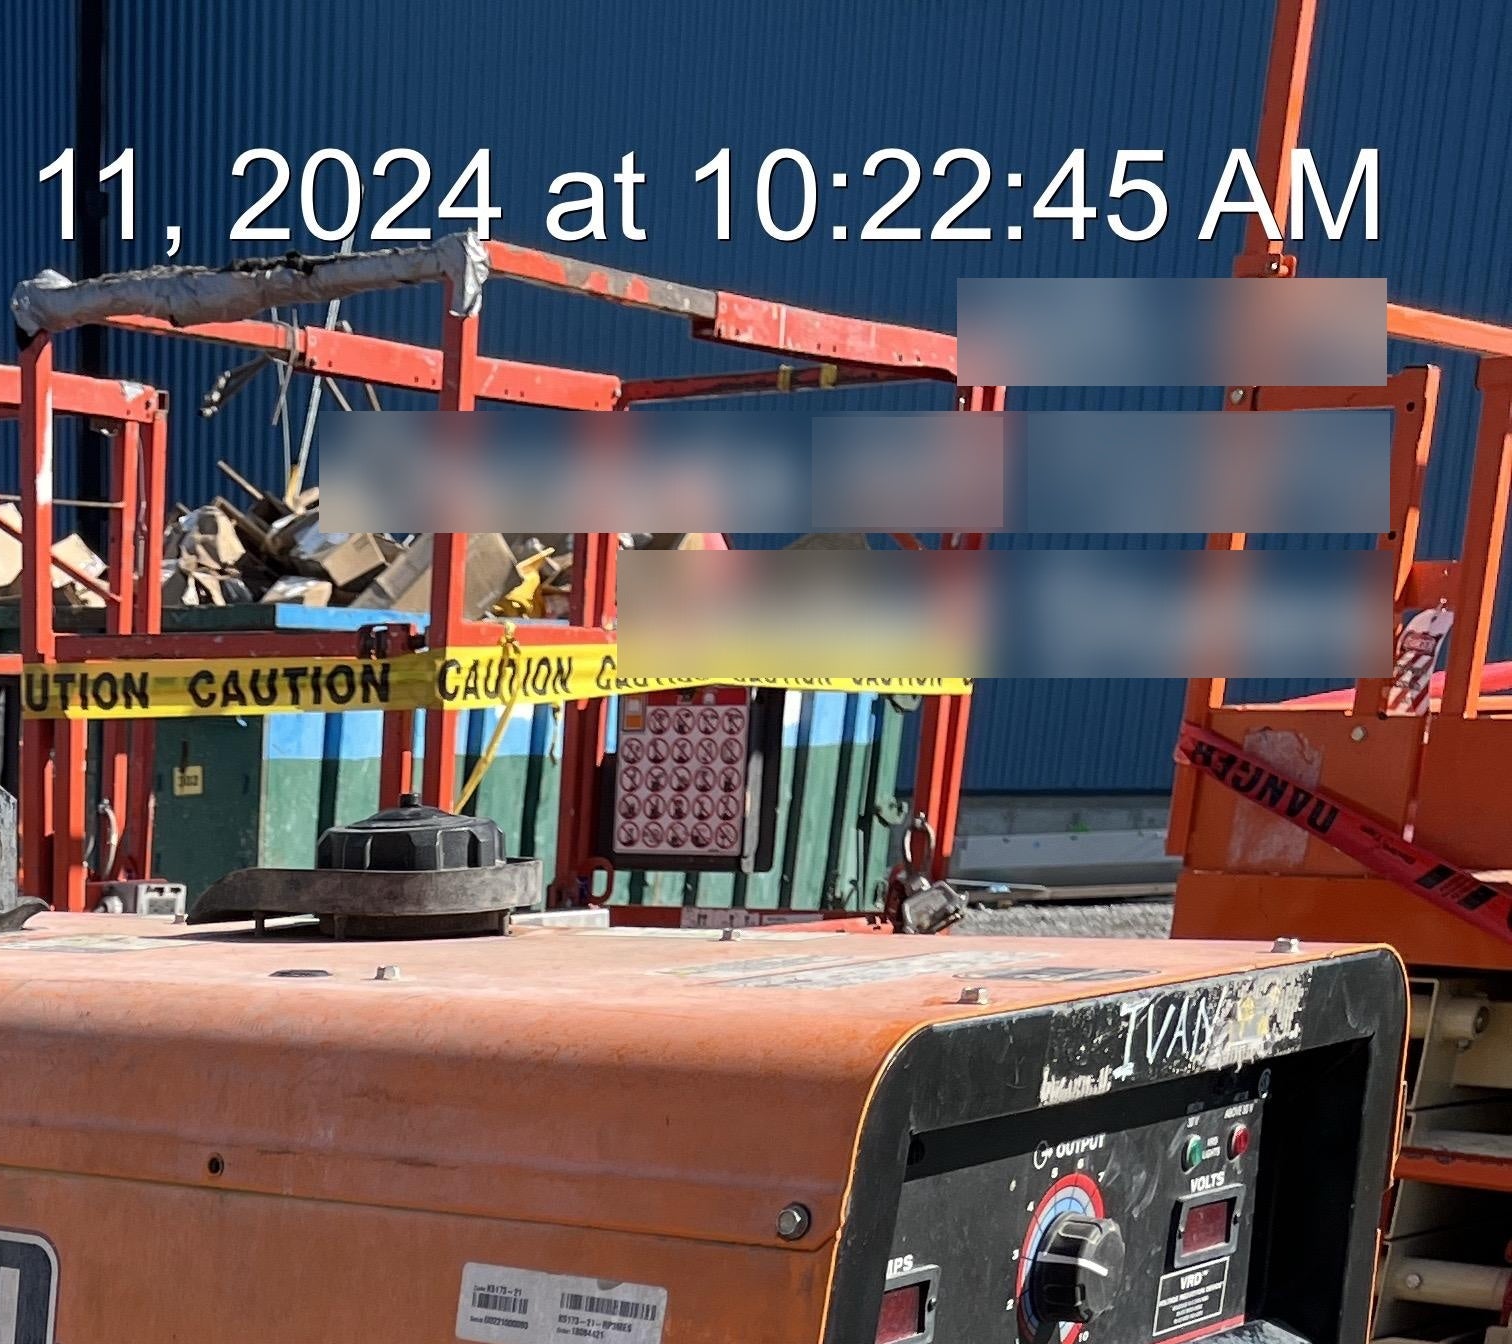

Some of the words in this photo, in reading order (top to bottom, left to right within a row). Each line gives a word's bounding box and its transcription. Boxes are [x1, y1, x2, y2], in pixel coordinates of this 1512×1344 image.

[24, 671, 150, 712] UTION
[188, 661, 392, 708] CAUTION
[438, 656, 575, 699] CAUTION
[1113, 988, 1228, 1081] IVAN
[1055, 1134, 1106, 1158] OUTPUT
[1190, 1171, 1225, 1193] VOLTS
[1026, 1201, 1035, 1212] 4
[1011, 1249, 1020, 1261] 3
[1006, 1299, 1014, 1311] 2
